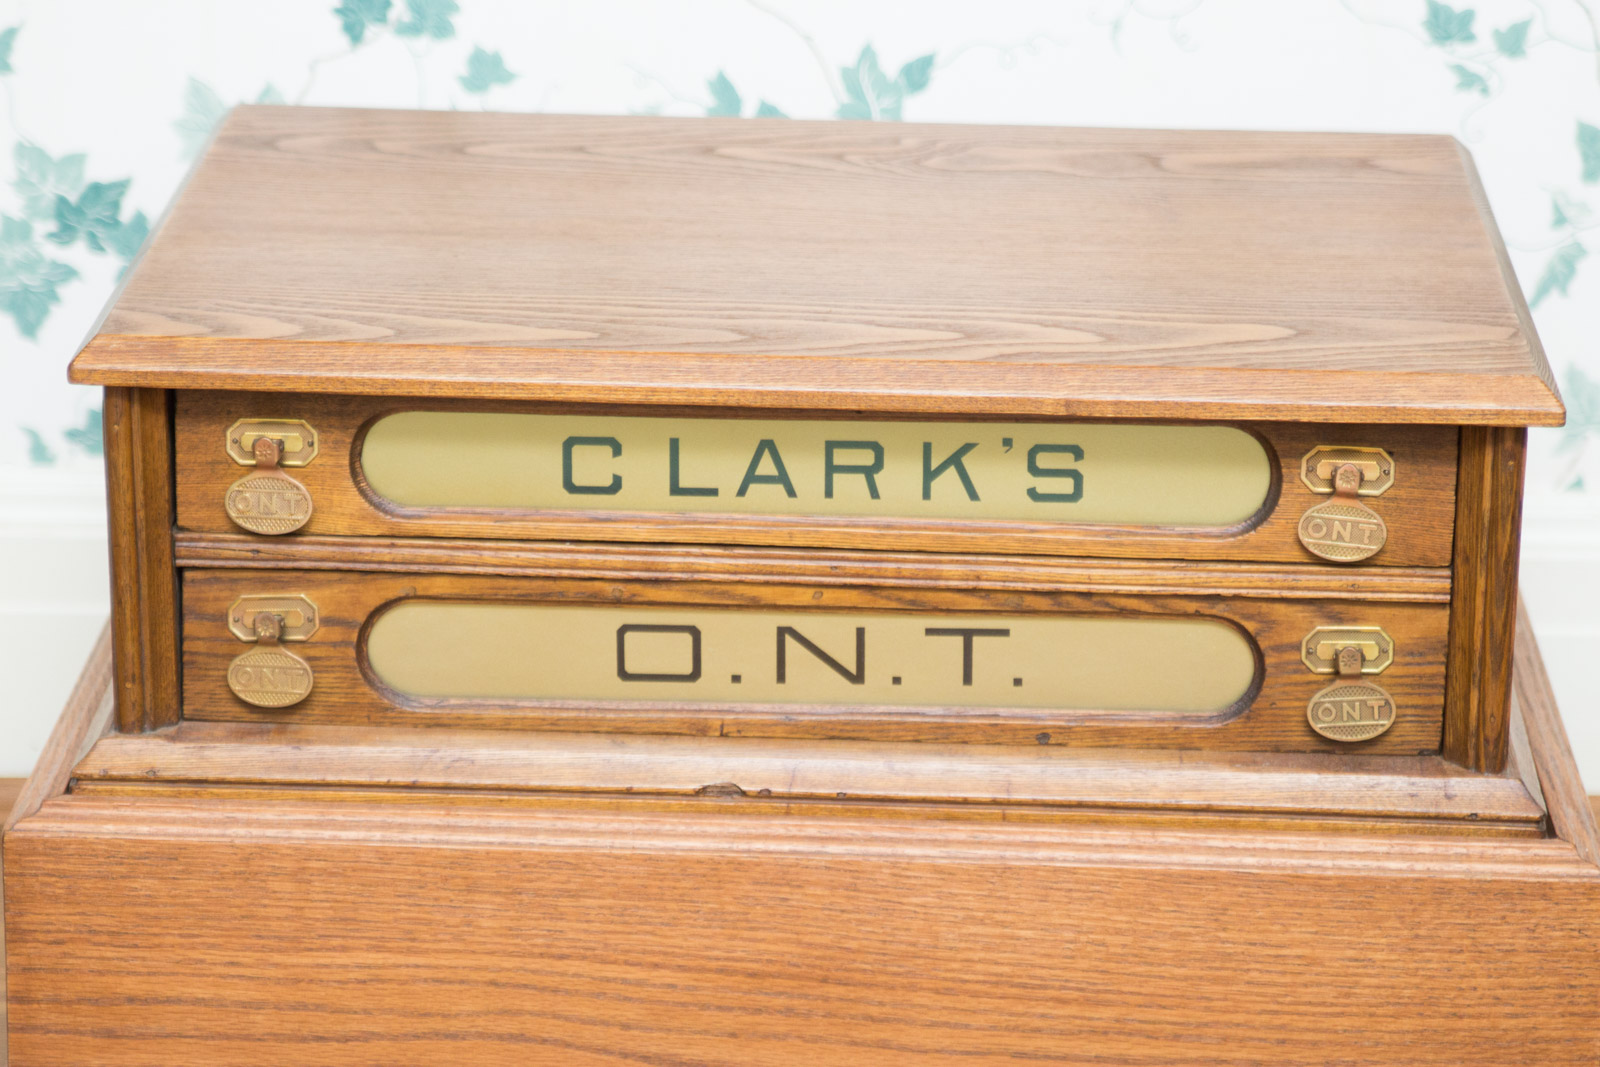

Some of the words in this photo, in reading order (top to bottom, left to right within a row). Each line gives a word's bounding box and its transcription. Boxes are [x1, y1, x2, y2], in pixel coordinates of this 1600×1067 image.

[562, 435, 1085, 503] CLARK'S
[235, 491, 303, 515] ONT
[1308, 518, 1378, 544] ONT
[616, 623, 1023, 687] O.N.T.
[237, 668, 304, 691] ONT
[1318, 699, 1386, 722] ONT
